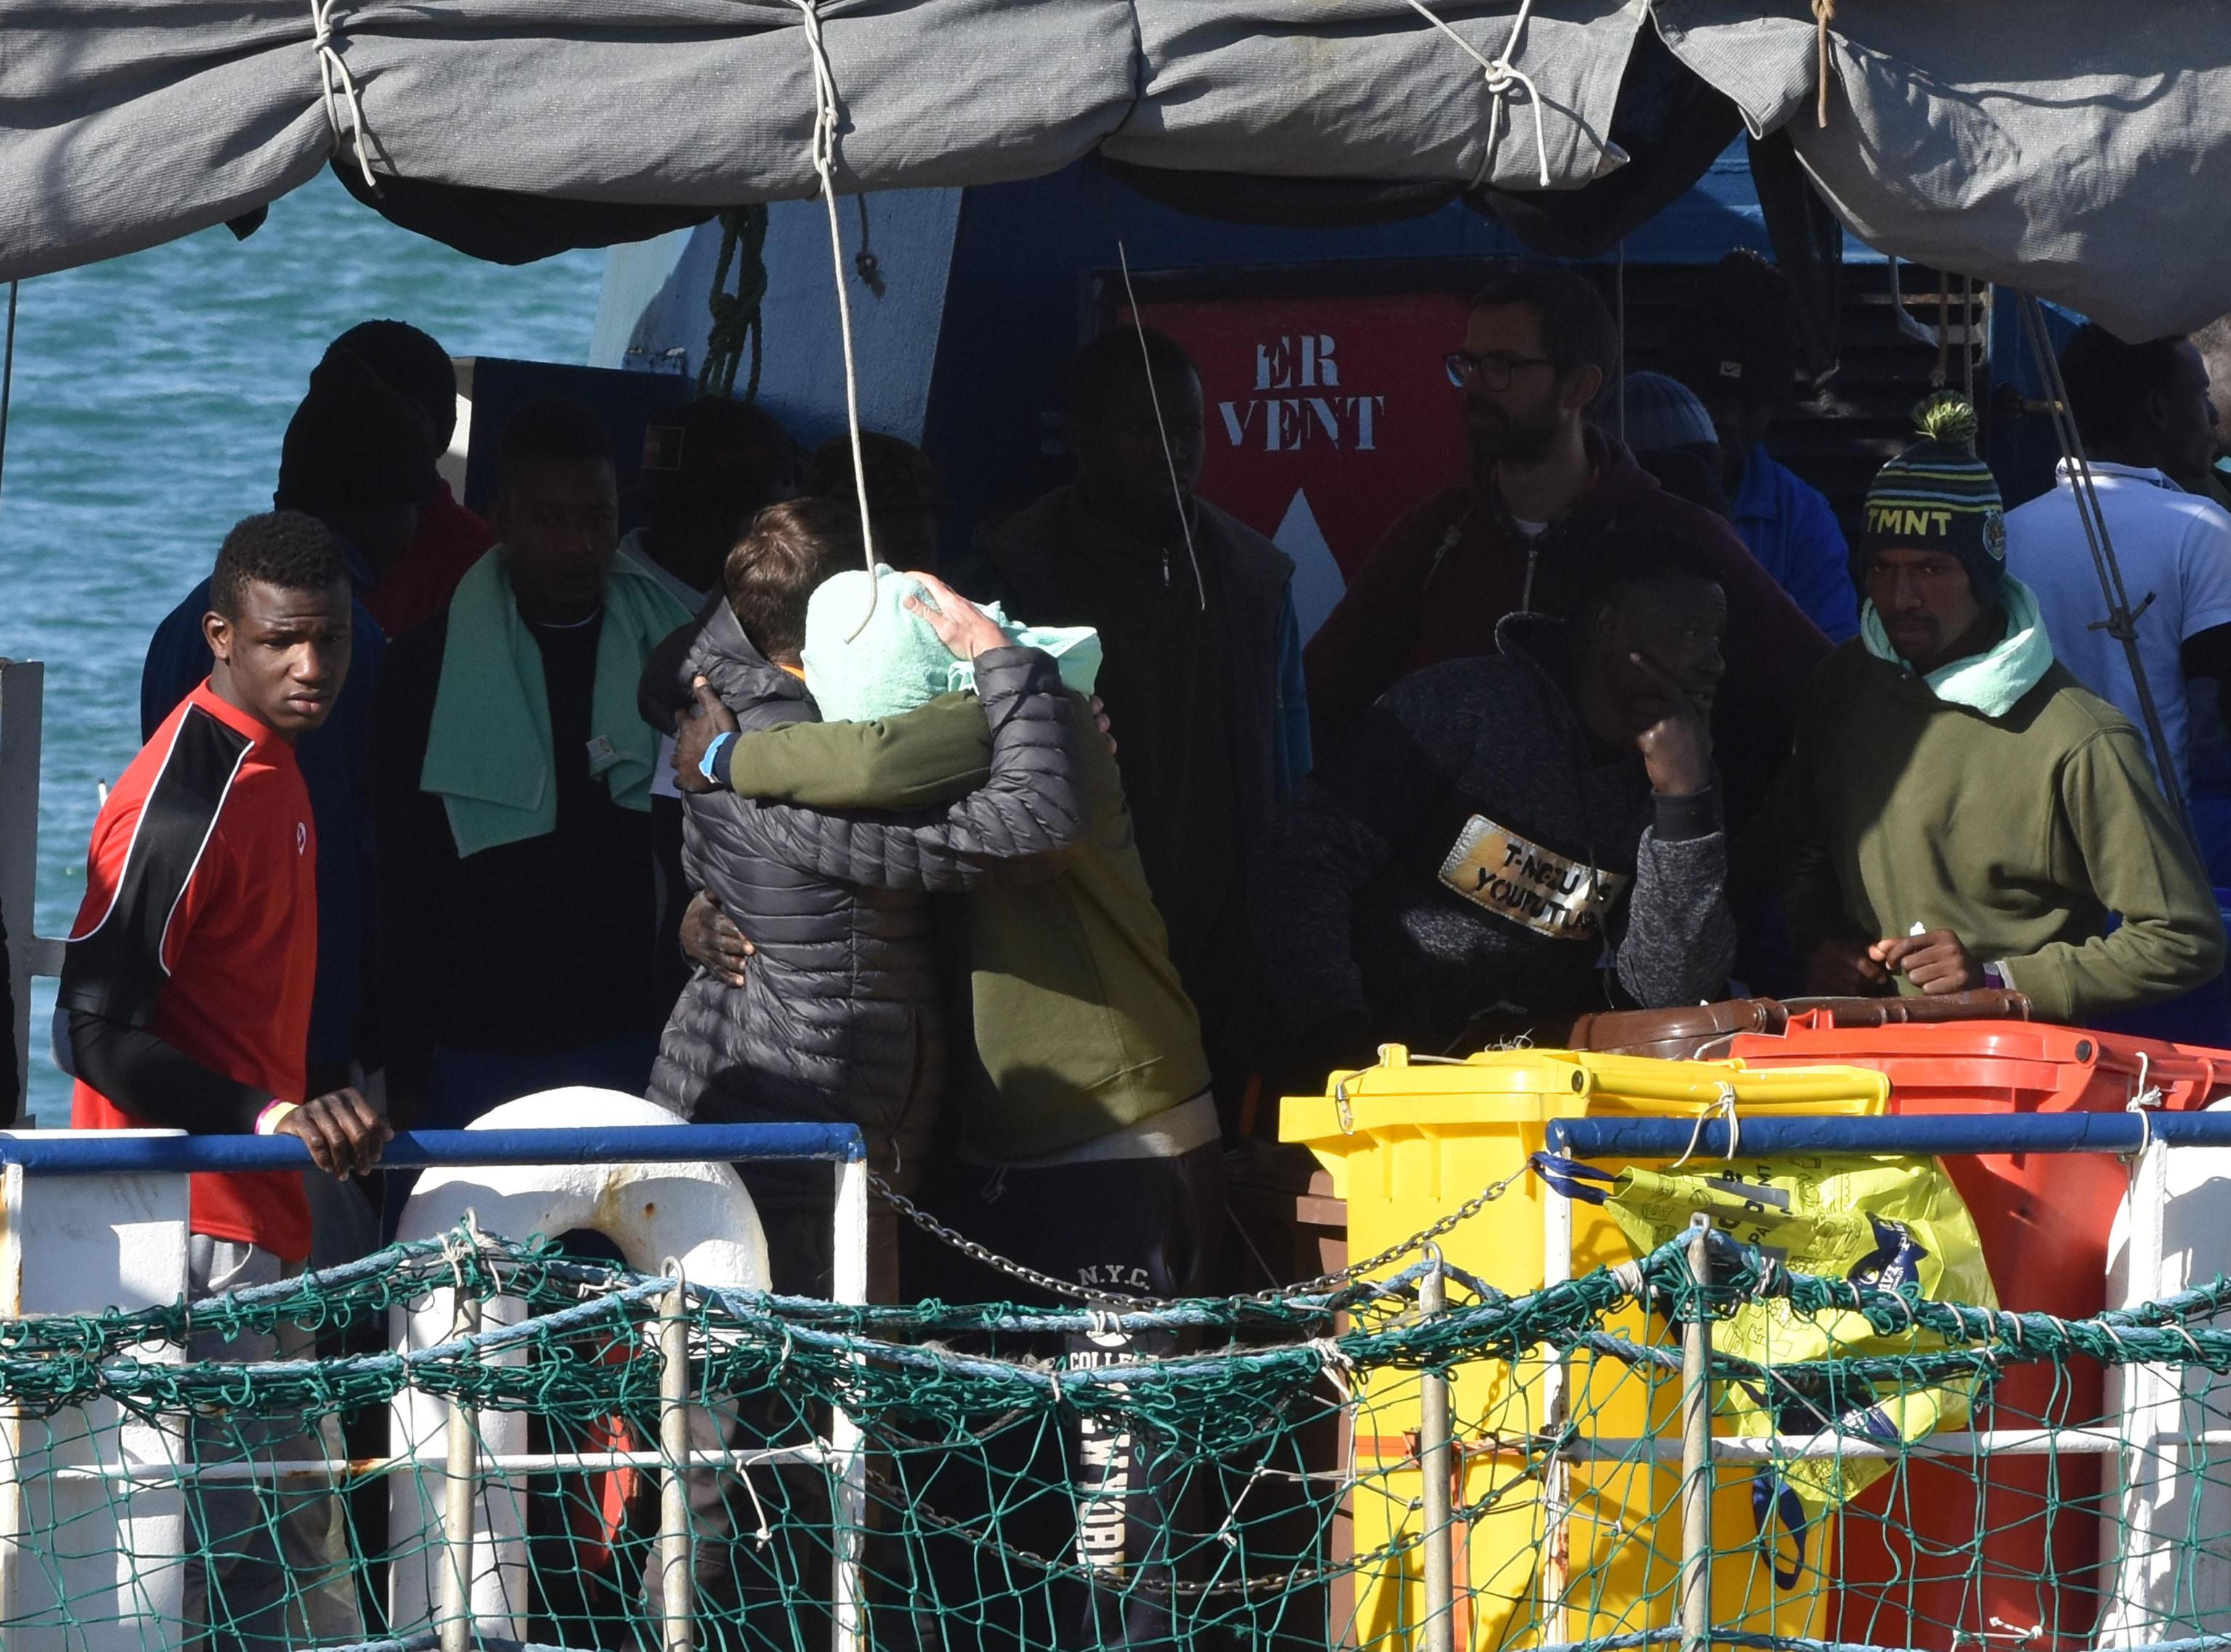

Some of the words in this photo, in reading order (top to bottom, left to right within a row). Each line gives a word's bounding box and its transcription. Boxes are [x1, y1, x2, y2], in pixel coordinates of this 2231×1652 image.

[1253, 333, 1340, 391] ER
[1217, 395, 1386, 452] VENT
[1866, 508, 1952, 537] TMNT
[1077, 1264, 1150, 1291] N.Y.C.
